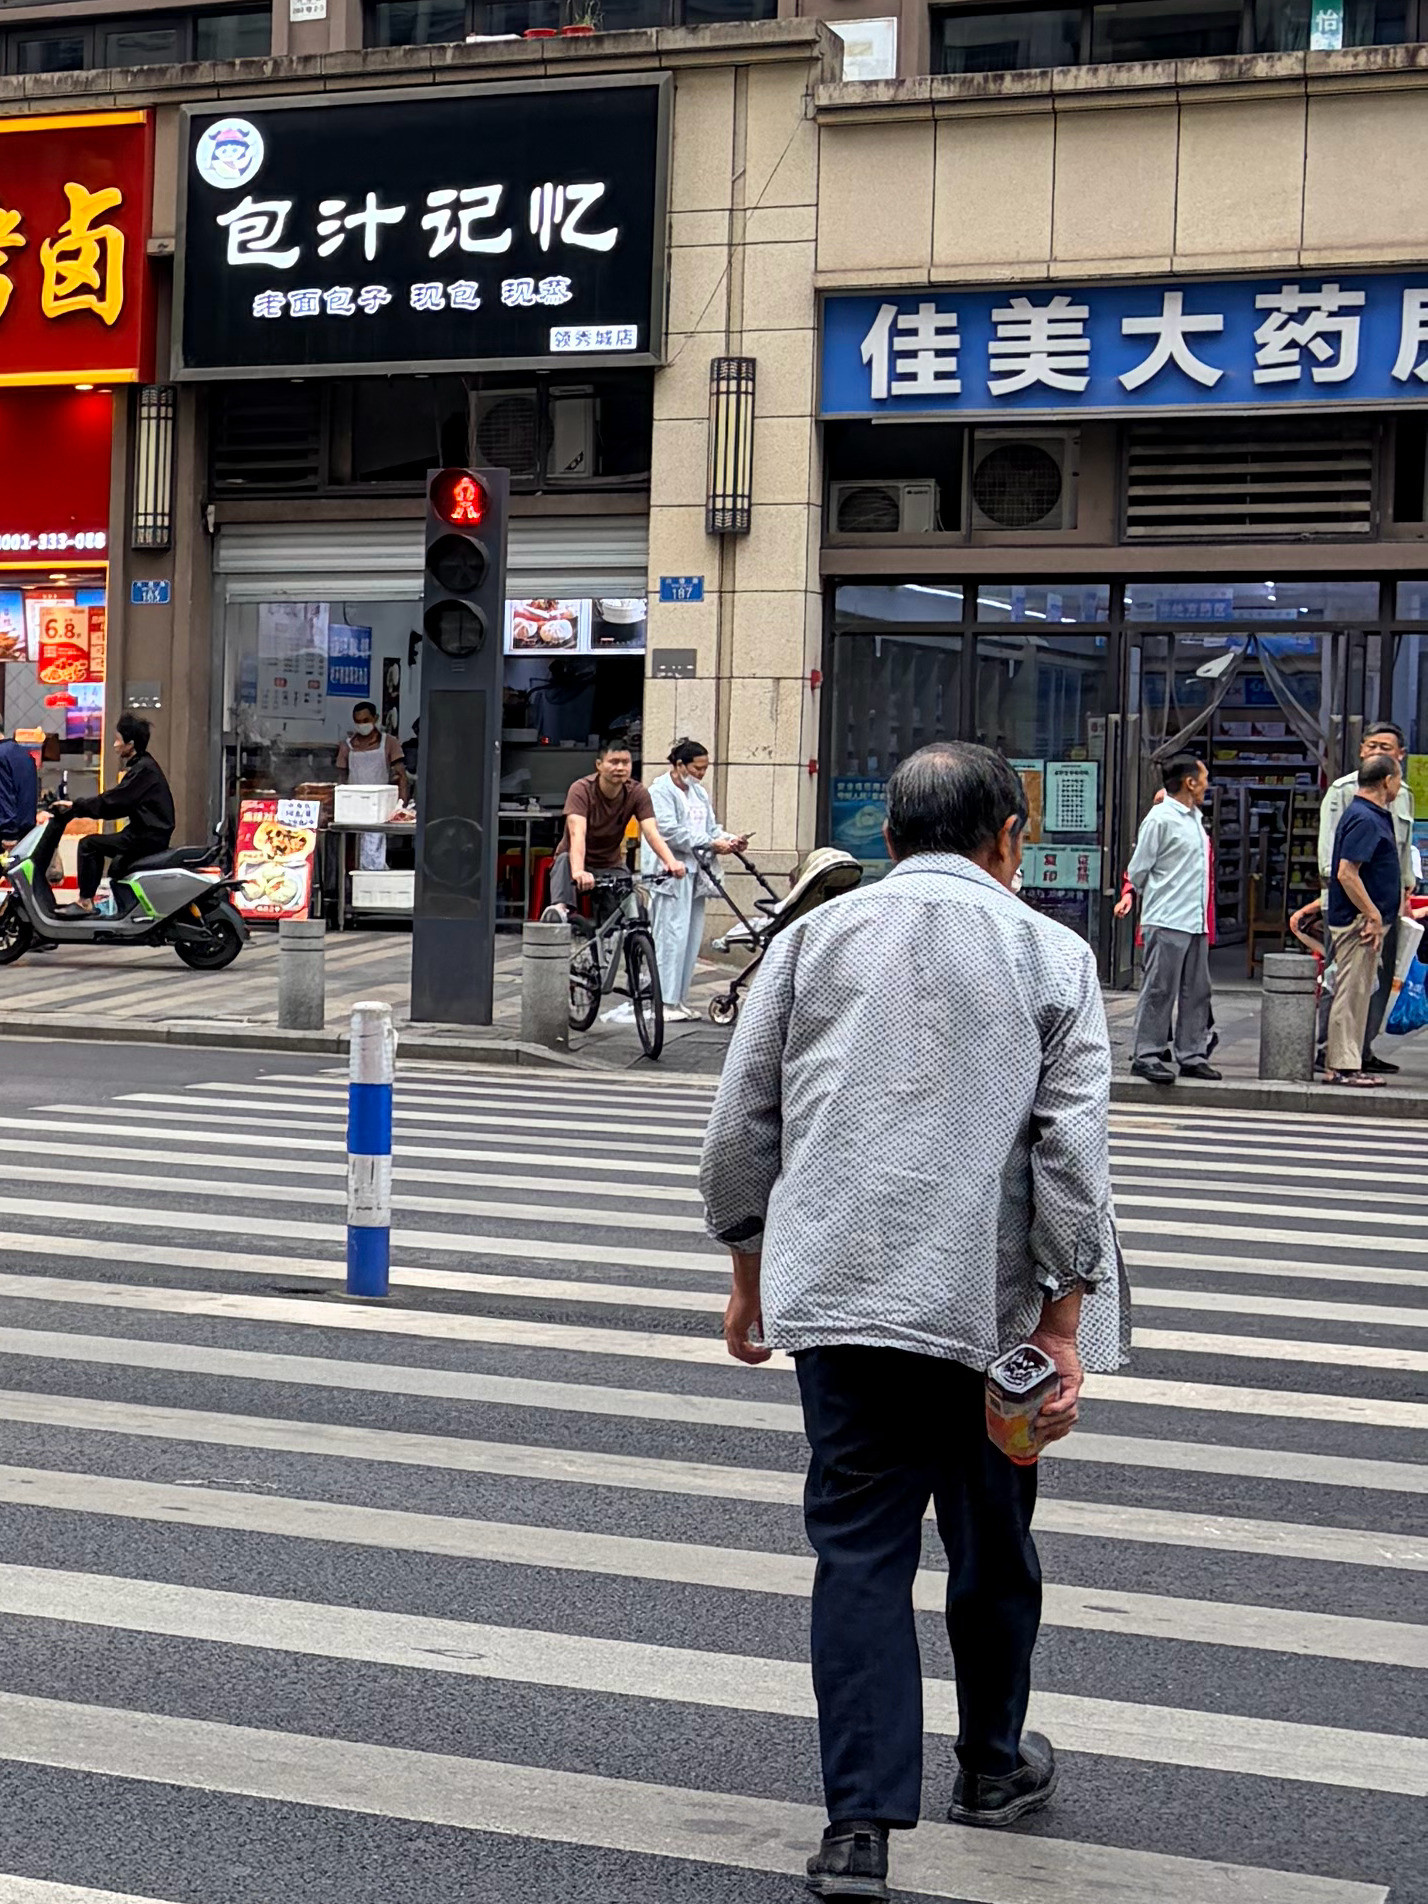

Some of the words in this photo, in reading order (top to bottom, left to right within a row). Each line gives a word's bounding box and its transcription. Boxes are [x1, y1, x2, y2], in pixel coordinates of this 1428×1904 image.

[216, 181, 618, 270] 包汁记忆
[252, 284, 392, 320] 老面包子
[409, 280, 481, 311] 现包
[501, 275, 573, 308] 现蒸
[671, 587, 693, 600] 187
